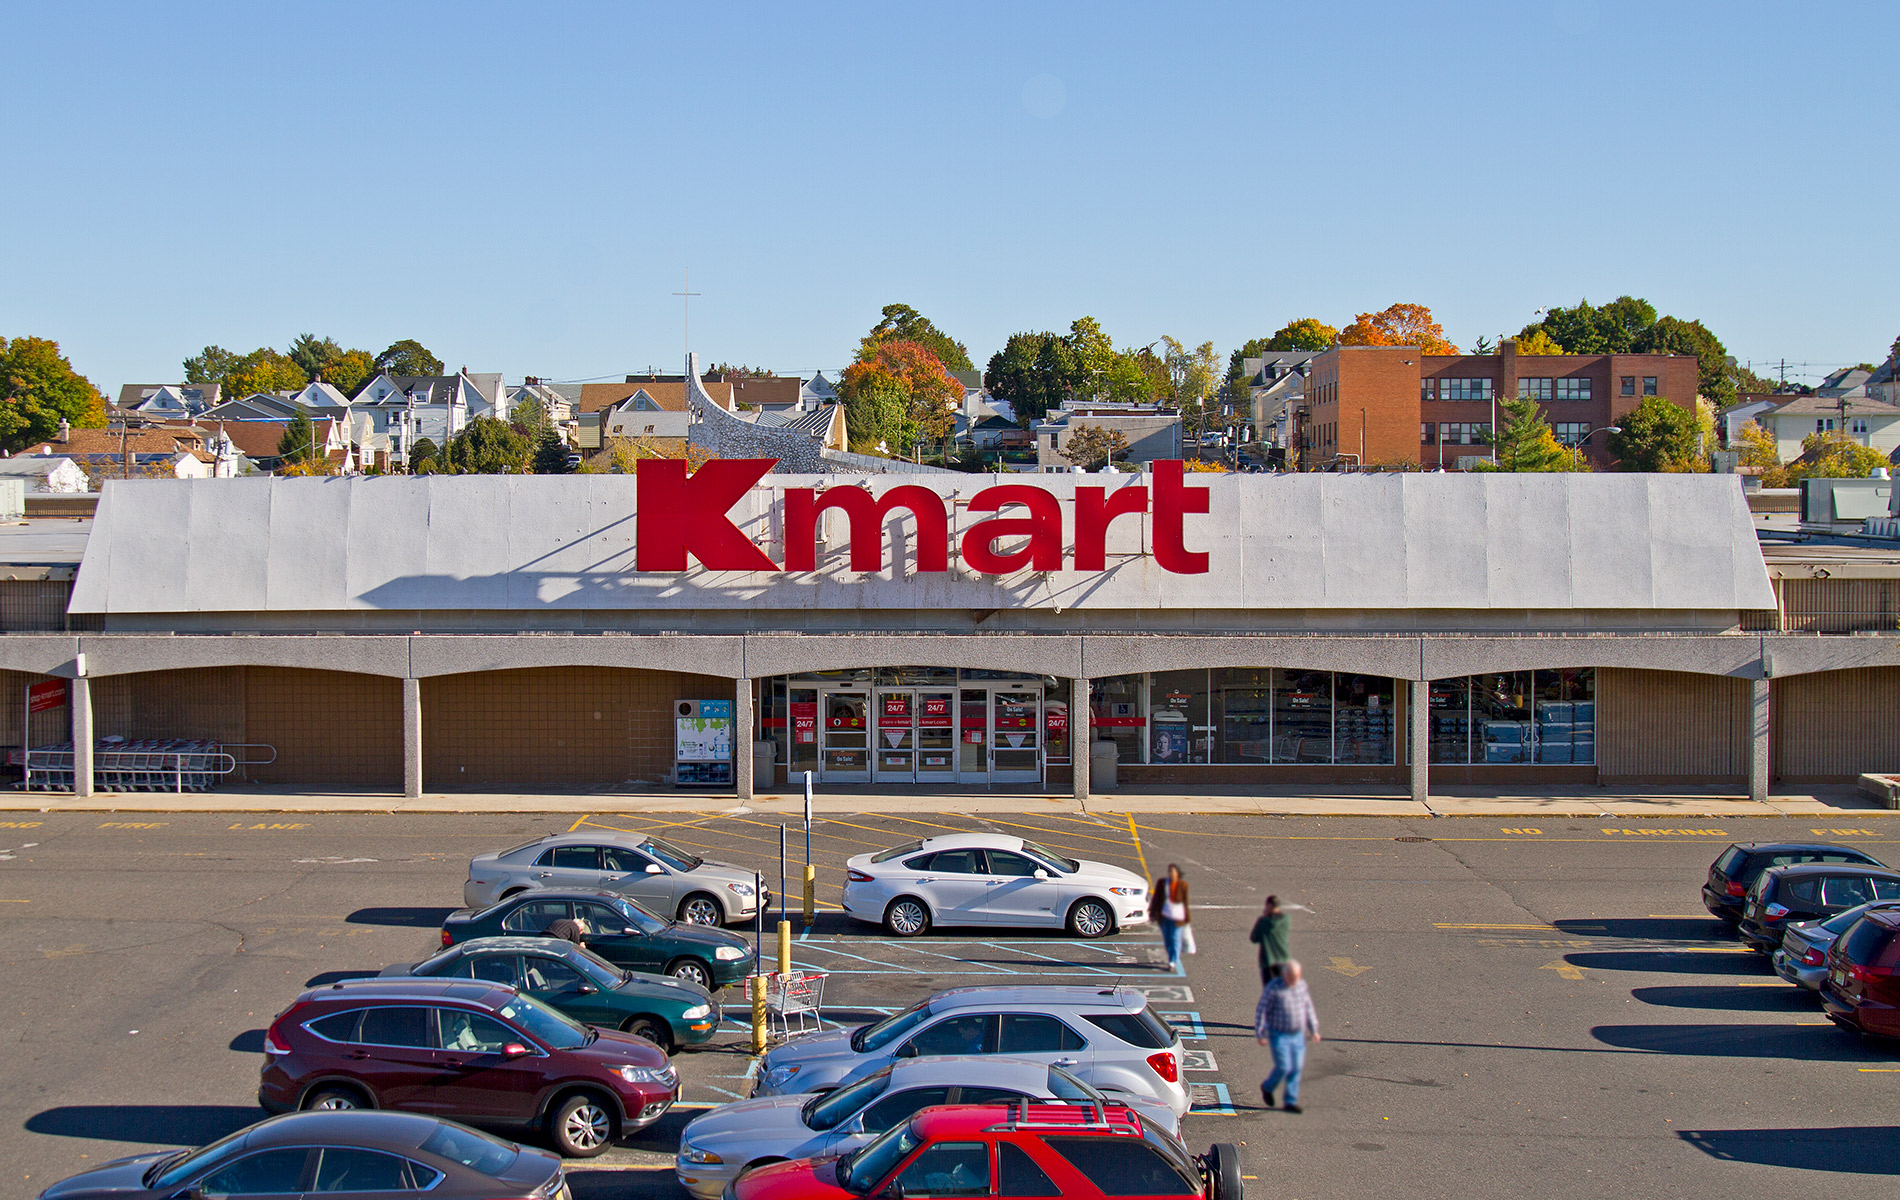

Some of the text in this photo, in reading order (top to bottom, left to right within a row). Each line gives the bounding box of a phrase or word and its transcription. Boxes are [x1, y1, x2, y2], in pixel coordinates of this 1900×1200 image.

[636, 458, 1210, 575] Kmart
[887, 704, 905, 712] 24/7
[927, 704, 945, 712] 24/7
[796, 720, 814, 728] 24/7
[1048, 719, 1066, 727] 24/7
[98, 822, 170, 830] FIRE
[228, 823, 312, 831] LANE
[1500, 827, 1884, 838] NO PARKING FIRE
